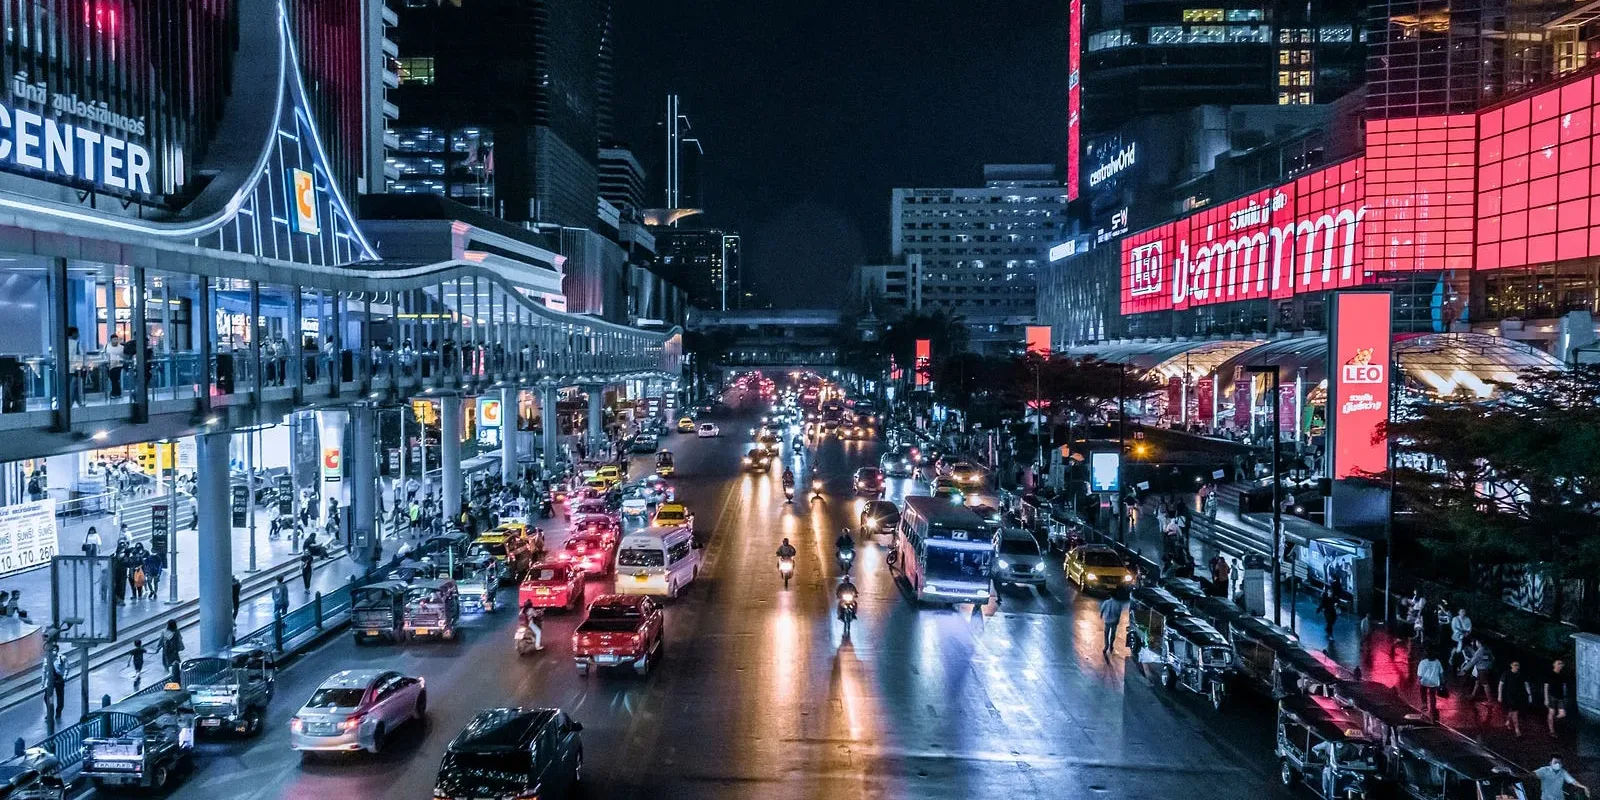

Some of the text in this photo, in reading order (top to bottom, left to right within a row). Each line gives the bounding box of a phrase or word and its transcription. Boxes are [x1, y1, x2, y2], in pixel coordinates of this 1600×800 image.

[1133, 245, 1160, 290] LEO
[1345, 367, 1381, 381] LEO
[18, 550, 34, 566] 170
[39, 545, 55, 561] 260
